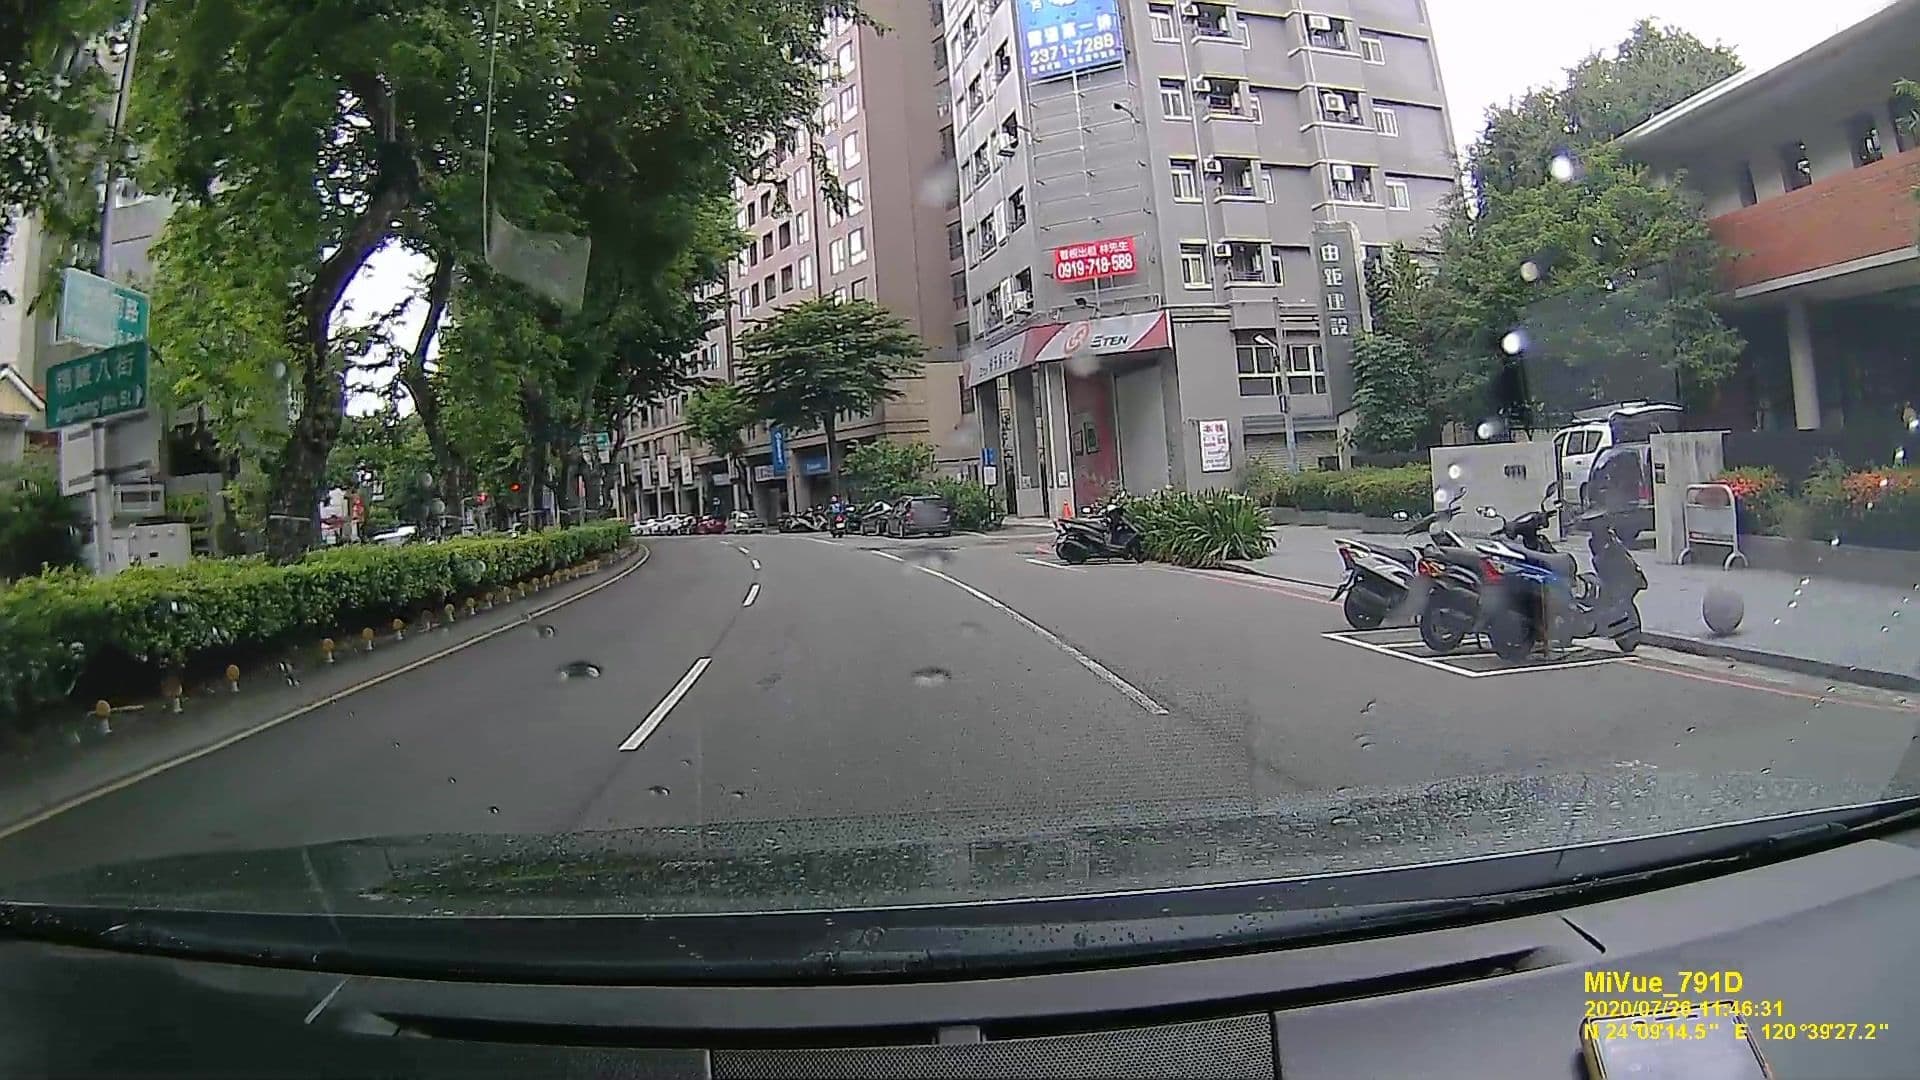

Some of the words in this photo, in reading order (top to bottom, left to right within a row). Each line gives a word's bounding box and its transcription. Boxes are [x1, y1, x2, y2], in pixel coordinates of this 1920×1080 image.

[1029, 33, 1115, 66] 2371-7288
[1057, 252, 1134, 279] 0919-718-588
[56, 352, 134, 393] 精八街
